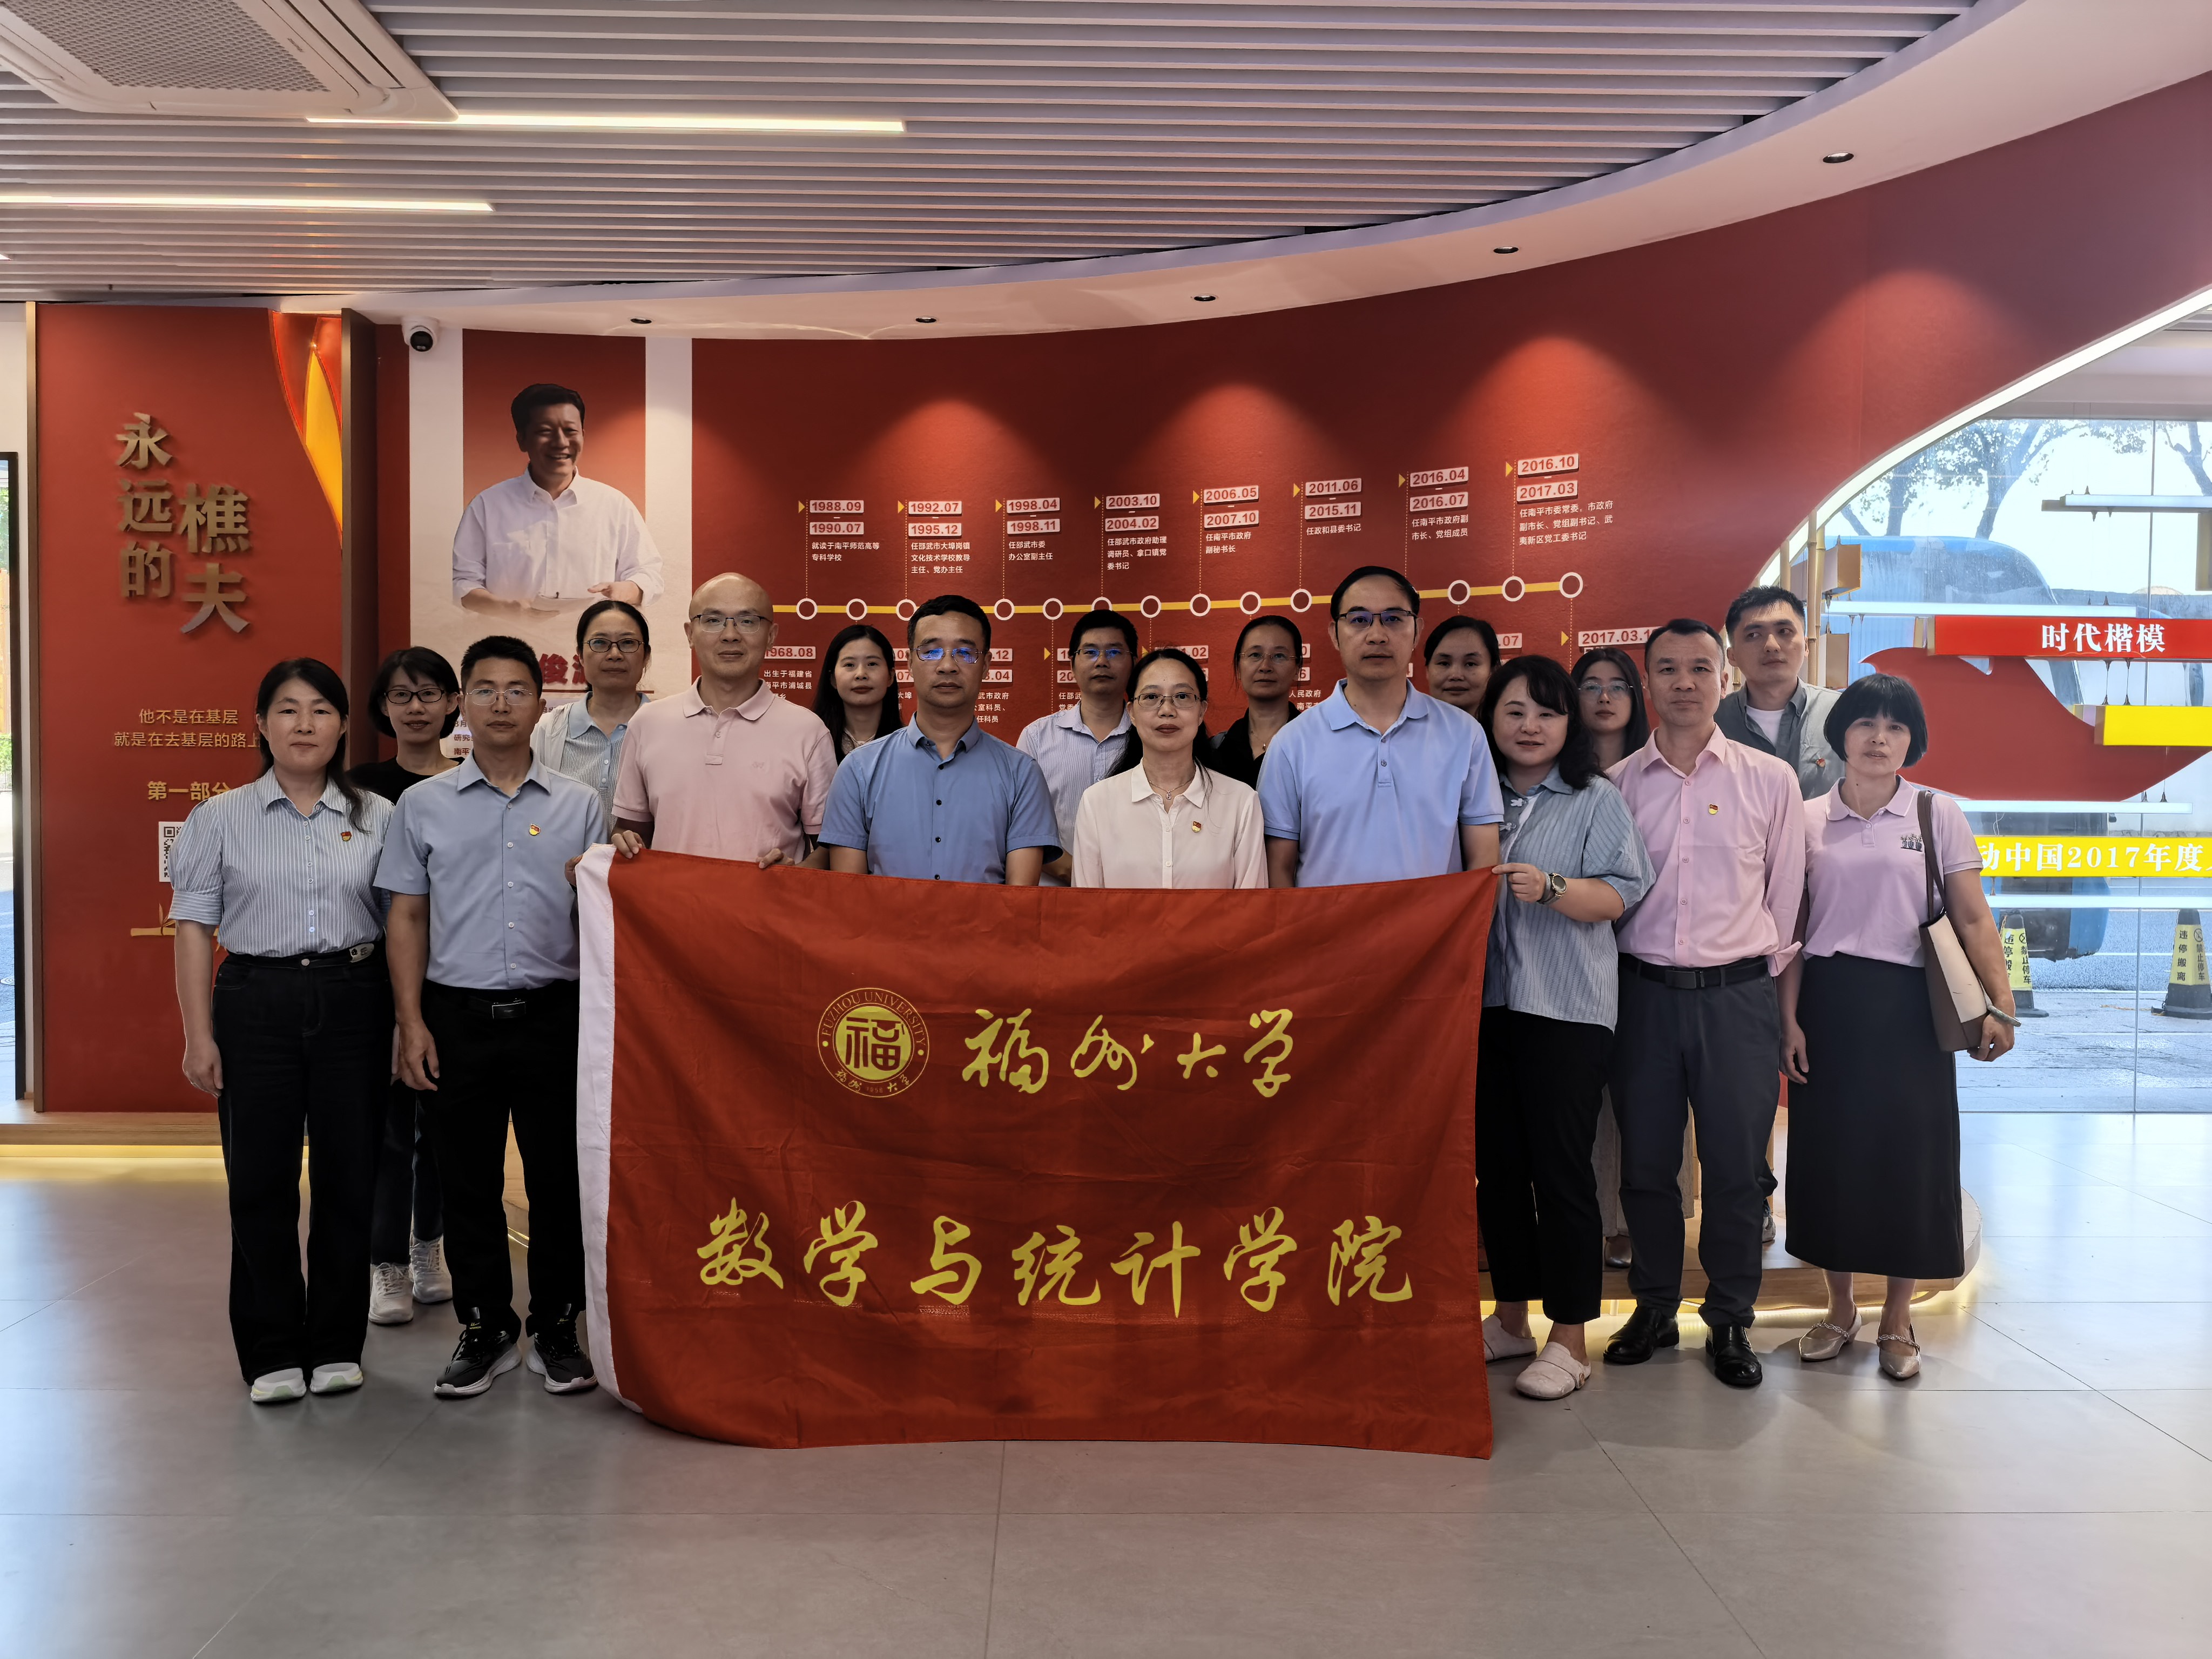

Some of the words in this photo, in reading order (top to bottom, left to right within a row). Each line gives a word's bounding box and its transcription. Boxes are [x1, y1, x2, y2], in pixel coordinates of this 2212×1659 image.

[1522, 456, 1575, 473] 2016.10
[1413, 469, 1465, 485] 2016.04
[1309, 481, 1358, 494] 2011.06
[1520, 483, 1575, 499] 2017.03
[1206, 488, 1257, 501] 2006.05
[115, 412, 173, 597] 永远的
[812, 502, 861, 511] 1988.09
[911, 503, 959, 512] 1992.07
[1009, 500, 1057, 511] 1998.04
[1108, 496, 1157, 507] 2003.10
[1413, 494, 1465, 510] 2016.07
[1309, 504, 1357, 517] 2015.11
[1107, 518, 1157, 529] 2004.02
[1206, 512, 1256, 526] 2007.10
[1412, 514, 1468, 528] 任南平市政府副
[812, 523, 861, 533] 1990.07
[911, 524, 958, 535] 1995.12
[1010, 521, 1056, 532] 1998.11
[1306, 523, 1361, 536] 任政和县委书记
[1107, 536, 1167, 546] 任邵武市政府助理
[1205, 531, 1251, 542] 任南平市政府
[1412, 528, 1468, 541] 市长、党组成员
[1519, 531, 1587, 546] 夷新区党工委书记
[812, 542, 880, 550] 就读于南平师范高等
[1008, 541, 1046, 549] 任邵武市委
[1205, 544, 1236, 554] 副秘书长
[178, 483, 252, 633] 樵夫
[911, 554, 970, 562] 文化技术学校教导
[1008, 552, 1053, 561] 办公室副主任
[911, 565, 963, 574] 主任、党办主任
[1107, 562, 1129, 570] 委书记
[2041, 622, 2166, 653] 时代楷模
[138, 709, 239, 725] 他不是在基层
[114, 731, 259, 748] 就是在去基层的路上
[1980, 842, 2212, 872] 动中国2017年度
[821, 993, 860, 1036] FUZHOU
[865, 992, 926, 1046] UNIVERSITY
[962, 1008, 1294, 1098] 福州大学
[696, 1196, 1414, 1318] 数学与统计学院
